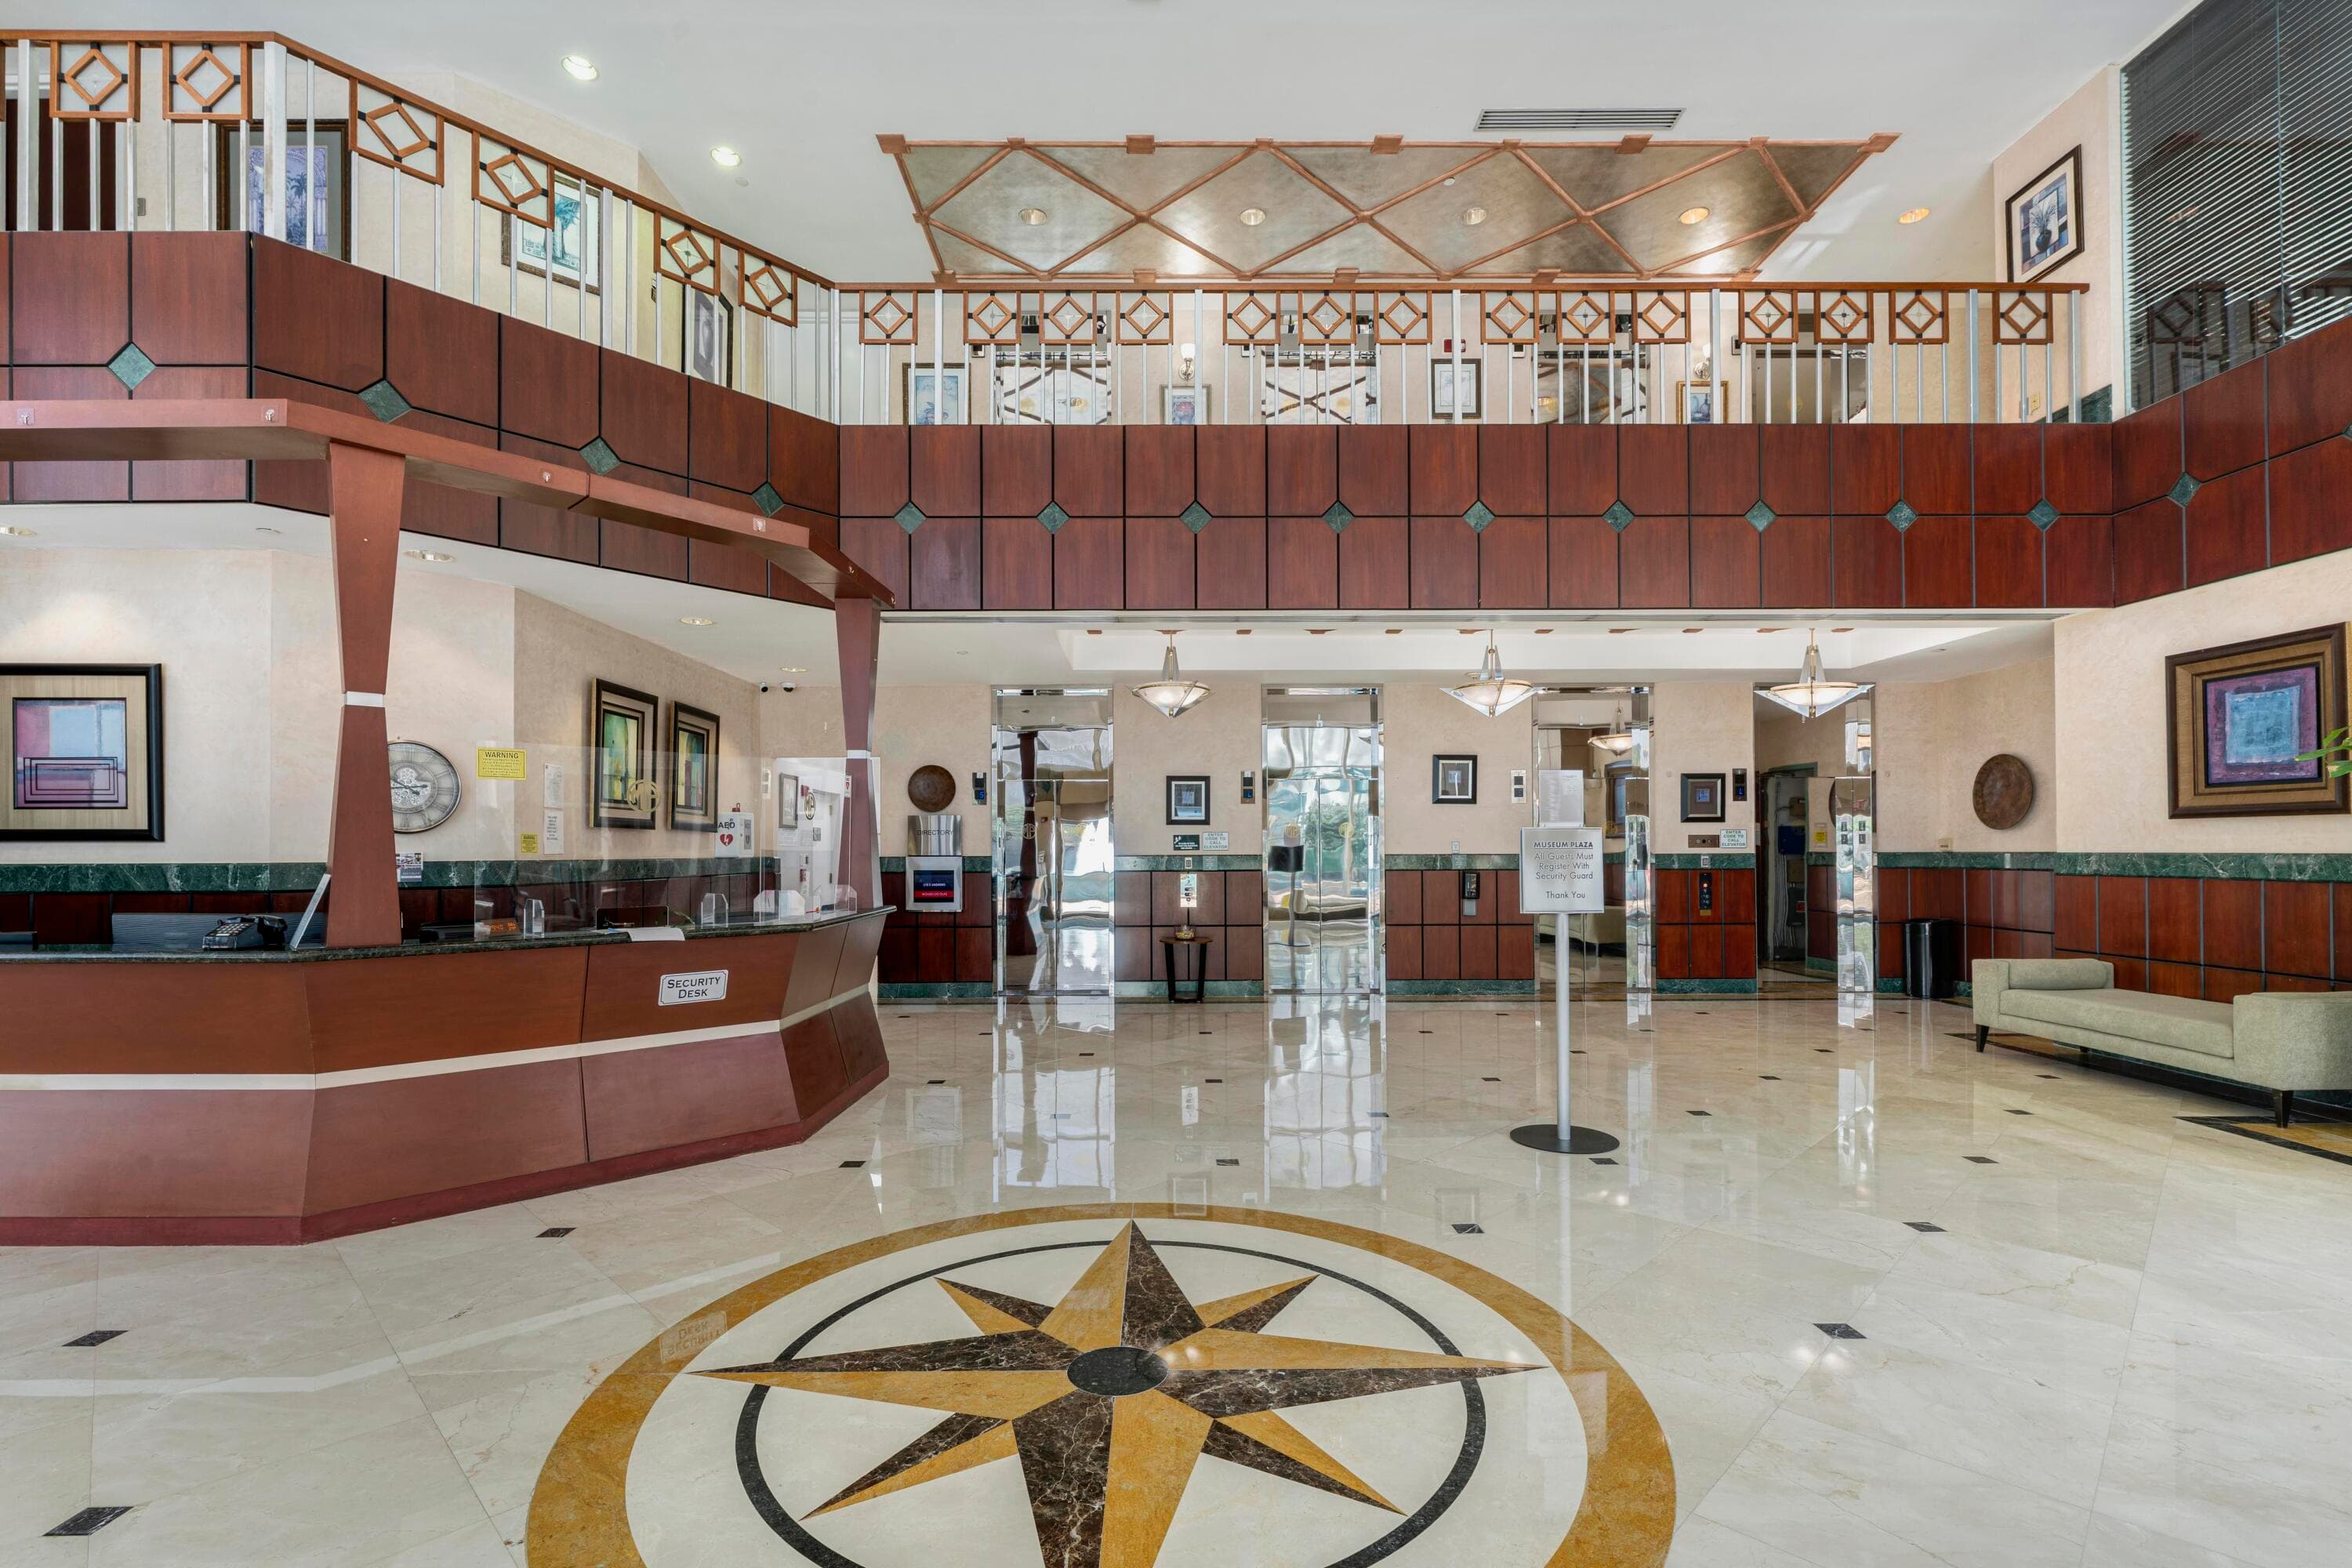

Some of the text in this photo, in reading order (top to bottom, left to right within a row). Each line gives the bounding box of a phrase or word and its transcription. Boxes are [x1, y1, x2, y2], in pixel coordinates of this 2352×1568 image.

[1539, 862, 1570, 871] Register
[1536, 872, 1566, 881] Security
[667, 977, 721, 989] SECURITY
[678, 989, 708, 999] DESK
